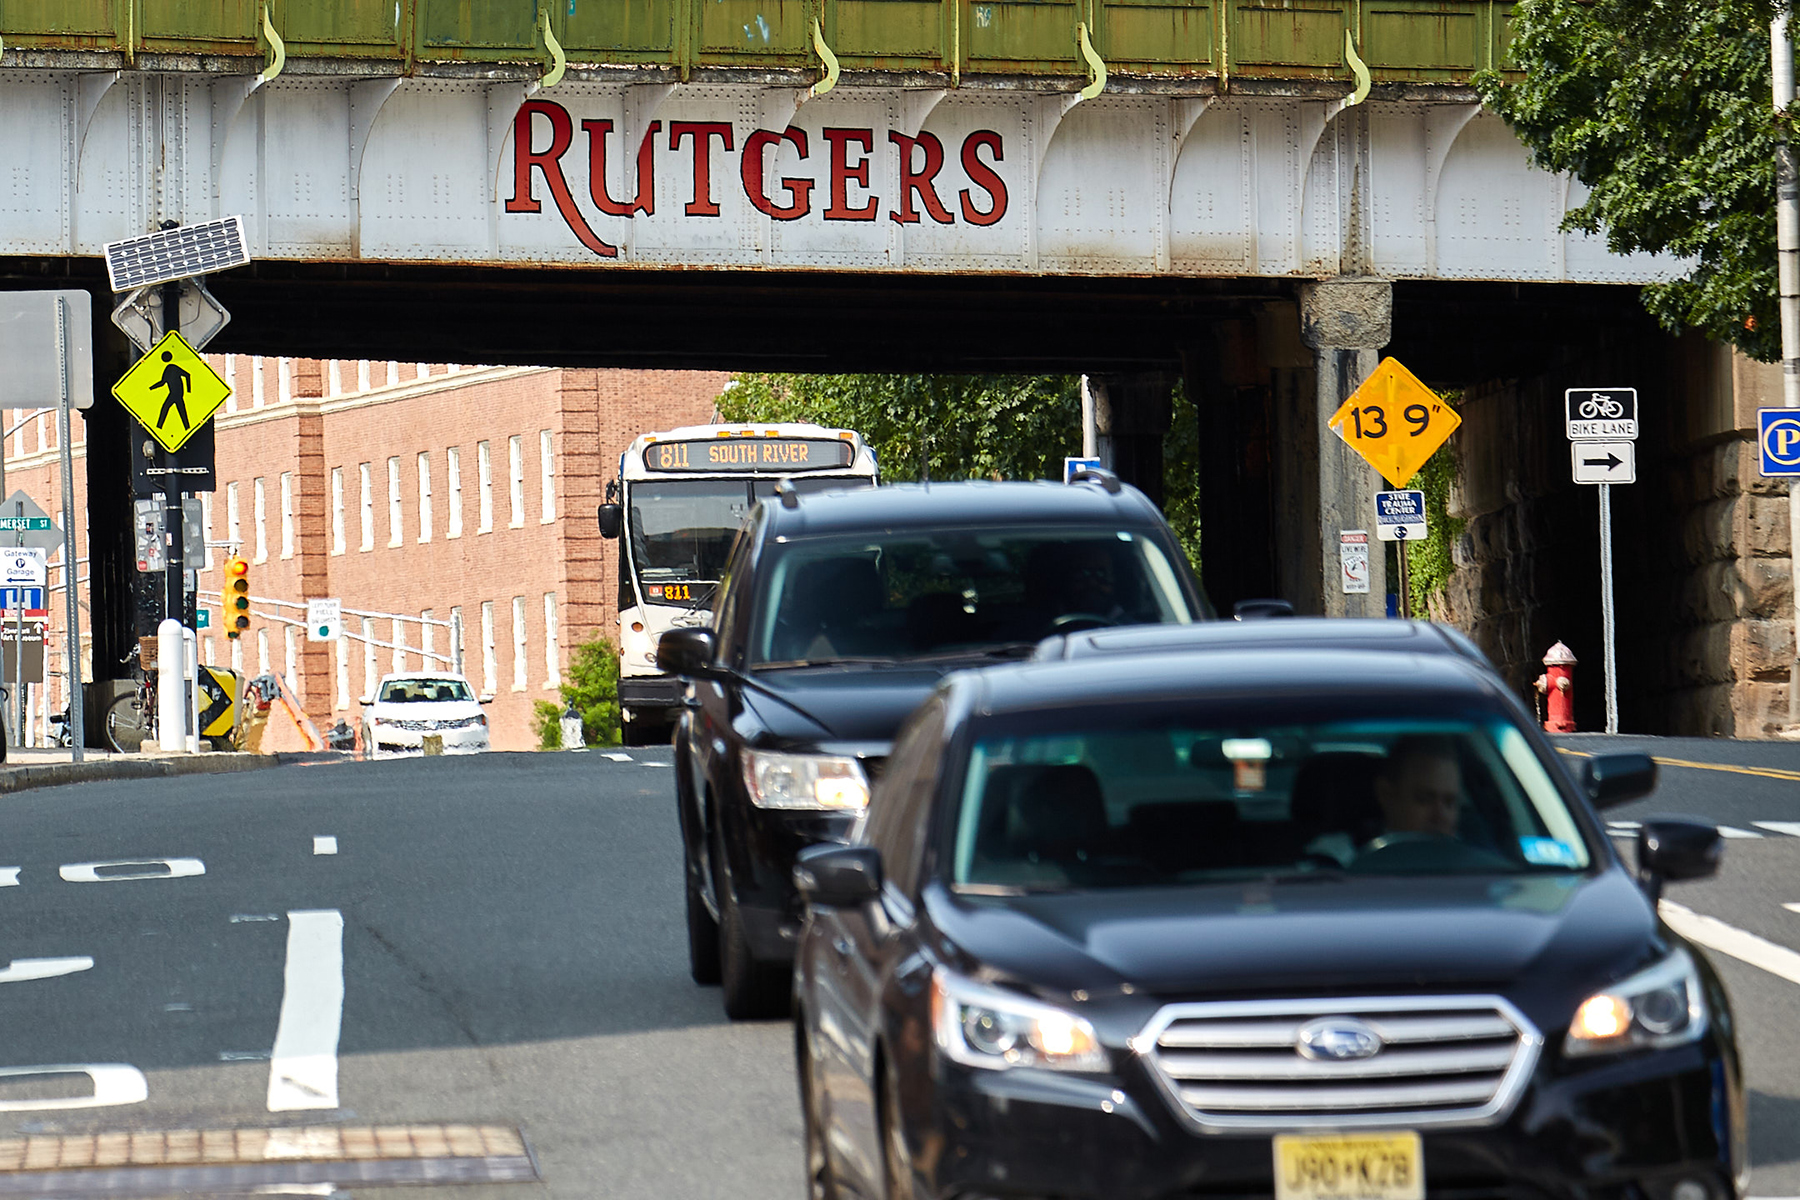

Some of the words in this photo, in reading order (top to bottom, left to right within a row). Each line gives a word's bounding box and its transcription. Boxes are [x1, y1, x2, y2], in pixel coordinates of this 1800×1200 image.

[505, 99, 1009, 258] RUTGERS
[1351, 405, 1388, 439] 13
[1571, 423, 1598, 435] BIKE
[1602, 422, 1635, 435] LANE
[660, 443, 690, 468] 811
[709, 444, 758, 463] SOUTH
[763, 443, 809, 463] RIVER
[1381, 500, 1417, 508] TRAUMA
[1384, 507, 1415, 515] CENTER
[4, 550, 38, 558] Gateway
[6, 568, 35, 576] Garage
[664, 585, 691, 600] 811
